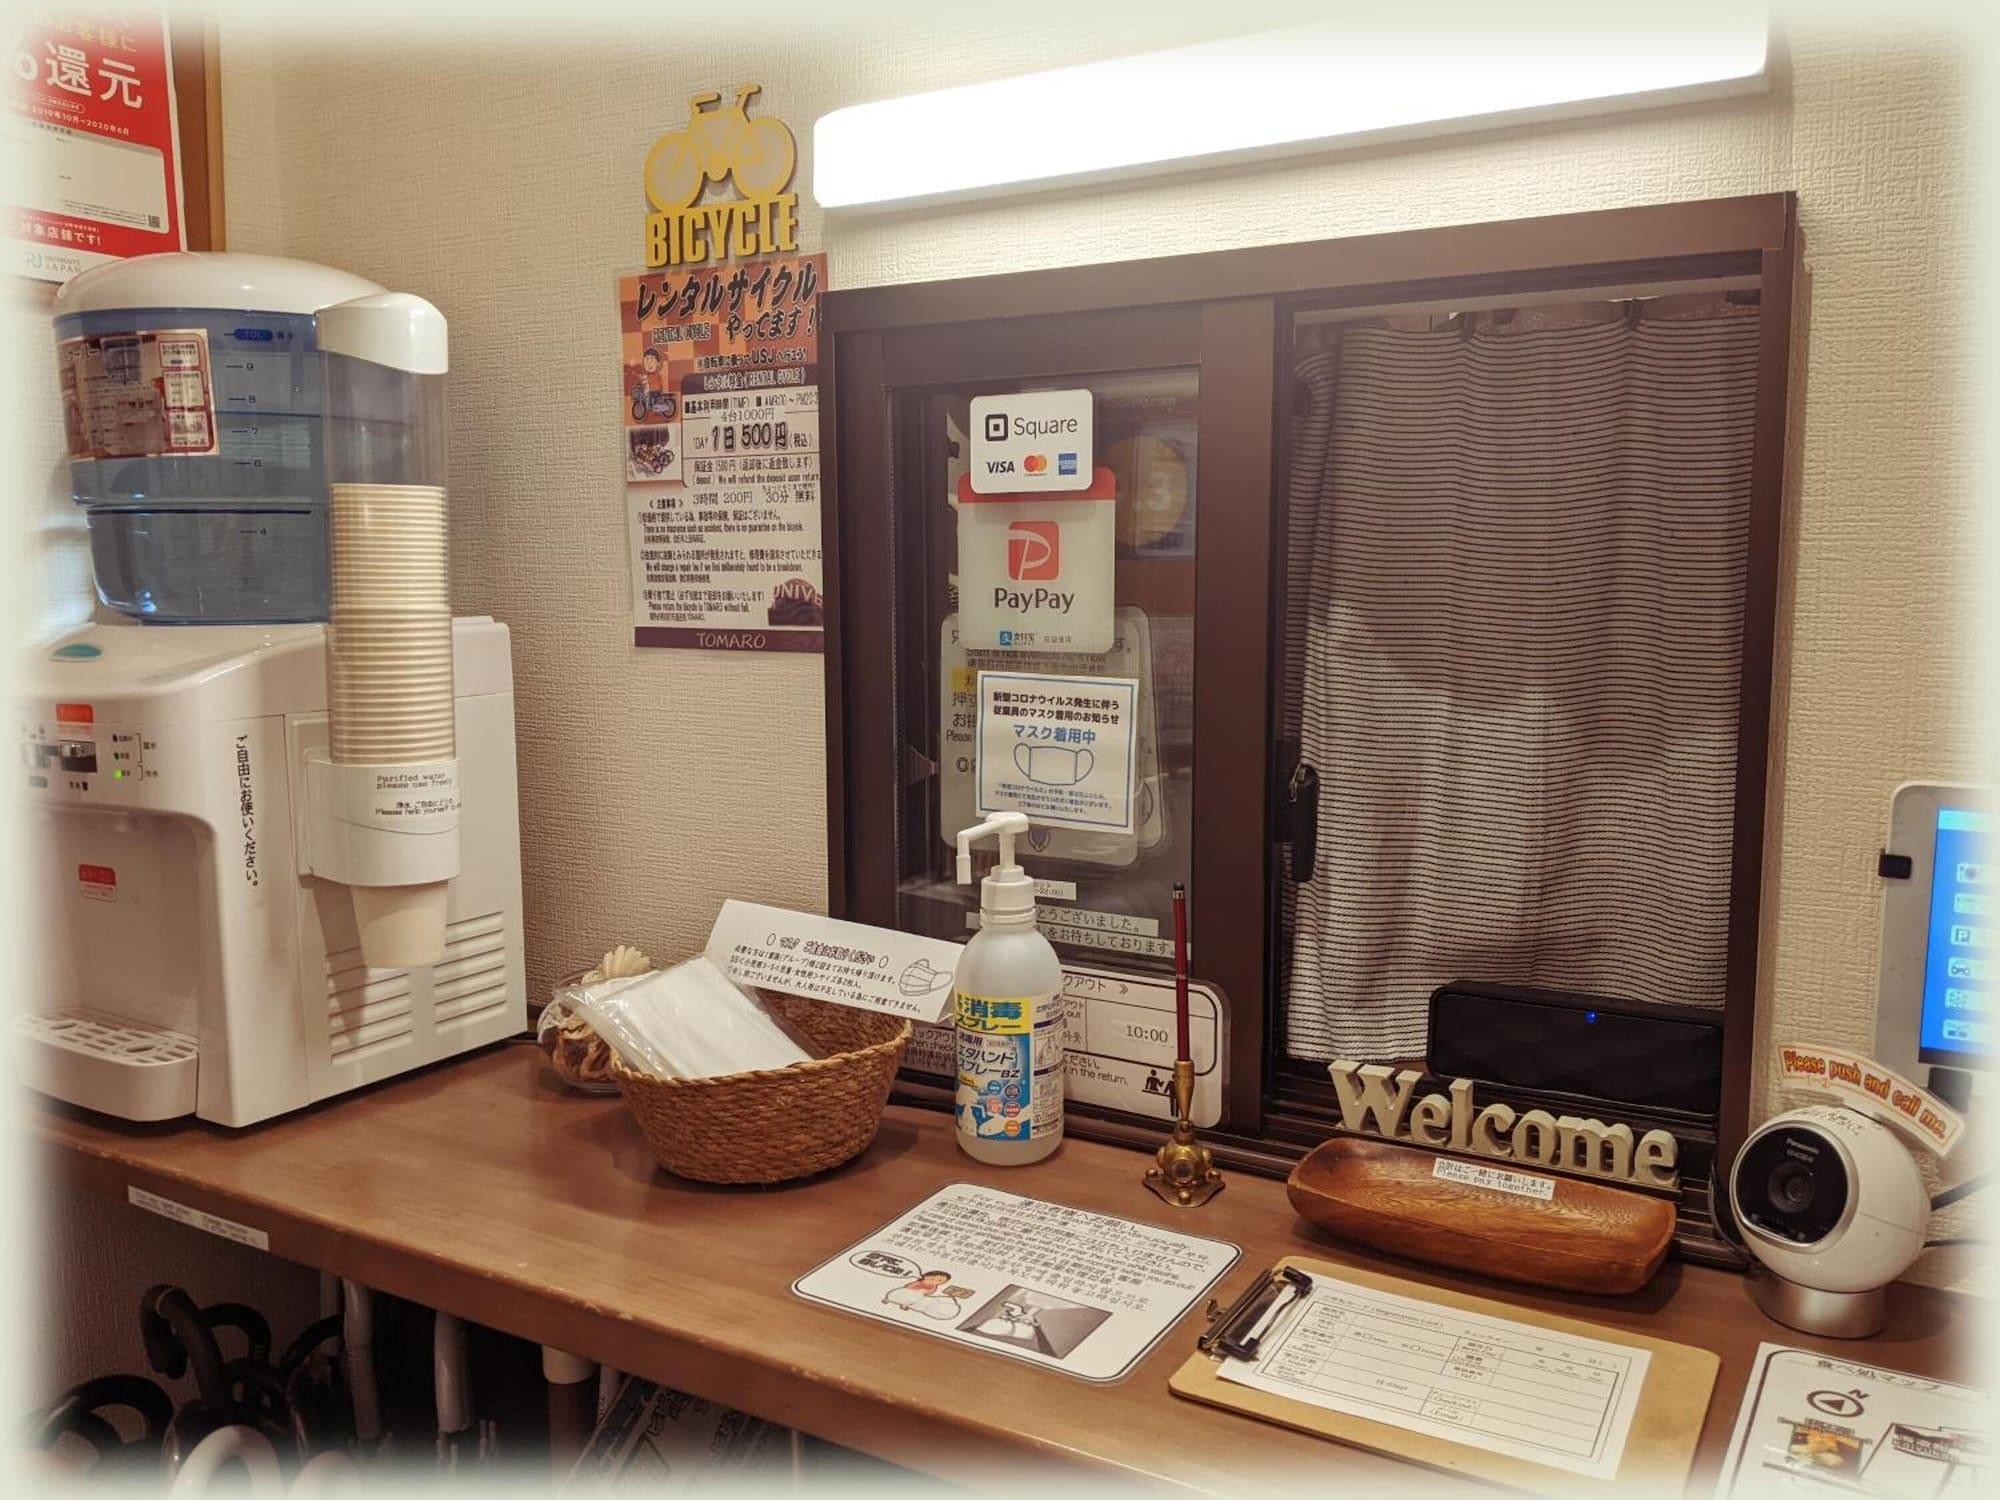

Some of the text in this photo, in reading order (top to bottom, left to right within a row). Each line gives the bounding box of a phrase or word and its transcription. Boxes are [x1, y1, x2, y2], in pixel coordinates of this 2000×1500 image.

[645, 195, 798, 268] BICYCLE
[637, 262, 817, 320] レンタルサイクル
[741, 421, 789, 450] 500円
[1014, 416, 1078, 440] Square
[986, 460, 1015, 474] VISA
[724, 491, 753, 504] 200円
[994, 588, 1075, 614] PayPay
[698, 633, 766, 649] TOMARO
[993, 691, 1120, 710] 新型コロナウイルス発生に伴う
[993, 705, 1119, 724] 従業員のマスク着用のお知らせ
[1013, 724, 1096, 744] マスク着用中
[236, 734, 259, 887] ご自由にお使いください。
[1036, 906, 1140, 932] とうございました。
[1127, 1024, 1169, 1043] 10:00
[1080, 1068, 1096, 1078] the
[1784, 1050, 1947, 1138] Please push and call me.
[1328, 1060, 1680, 1188] Welcome
